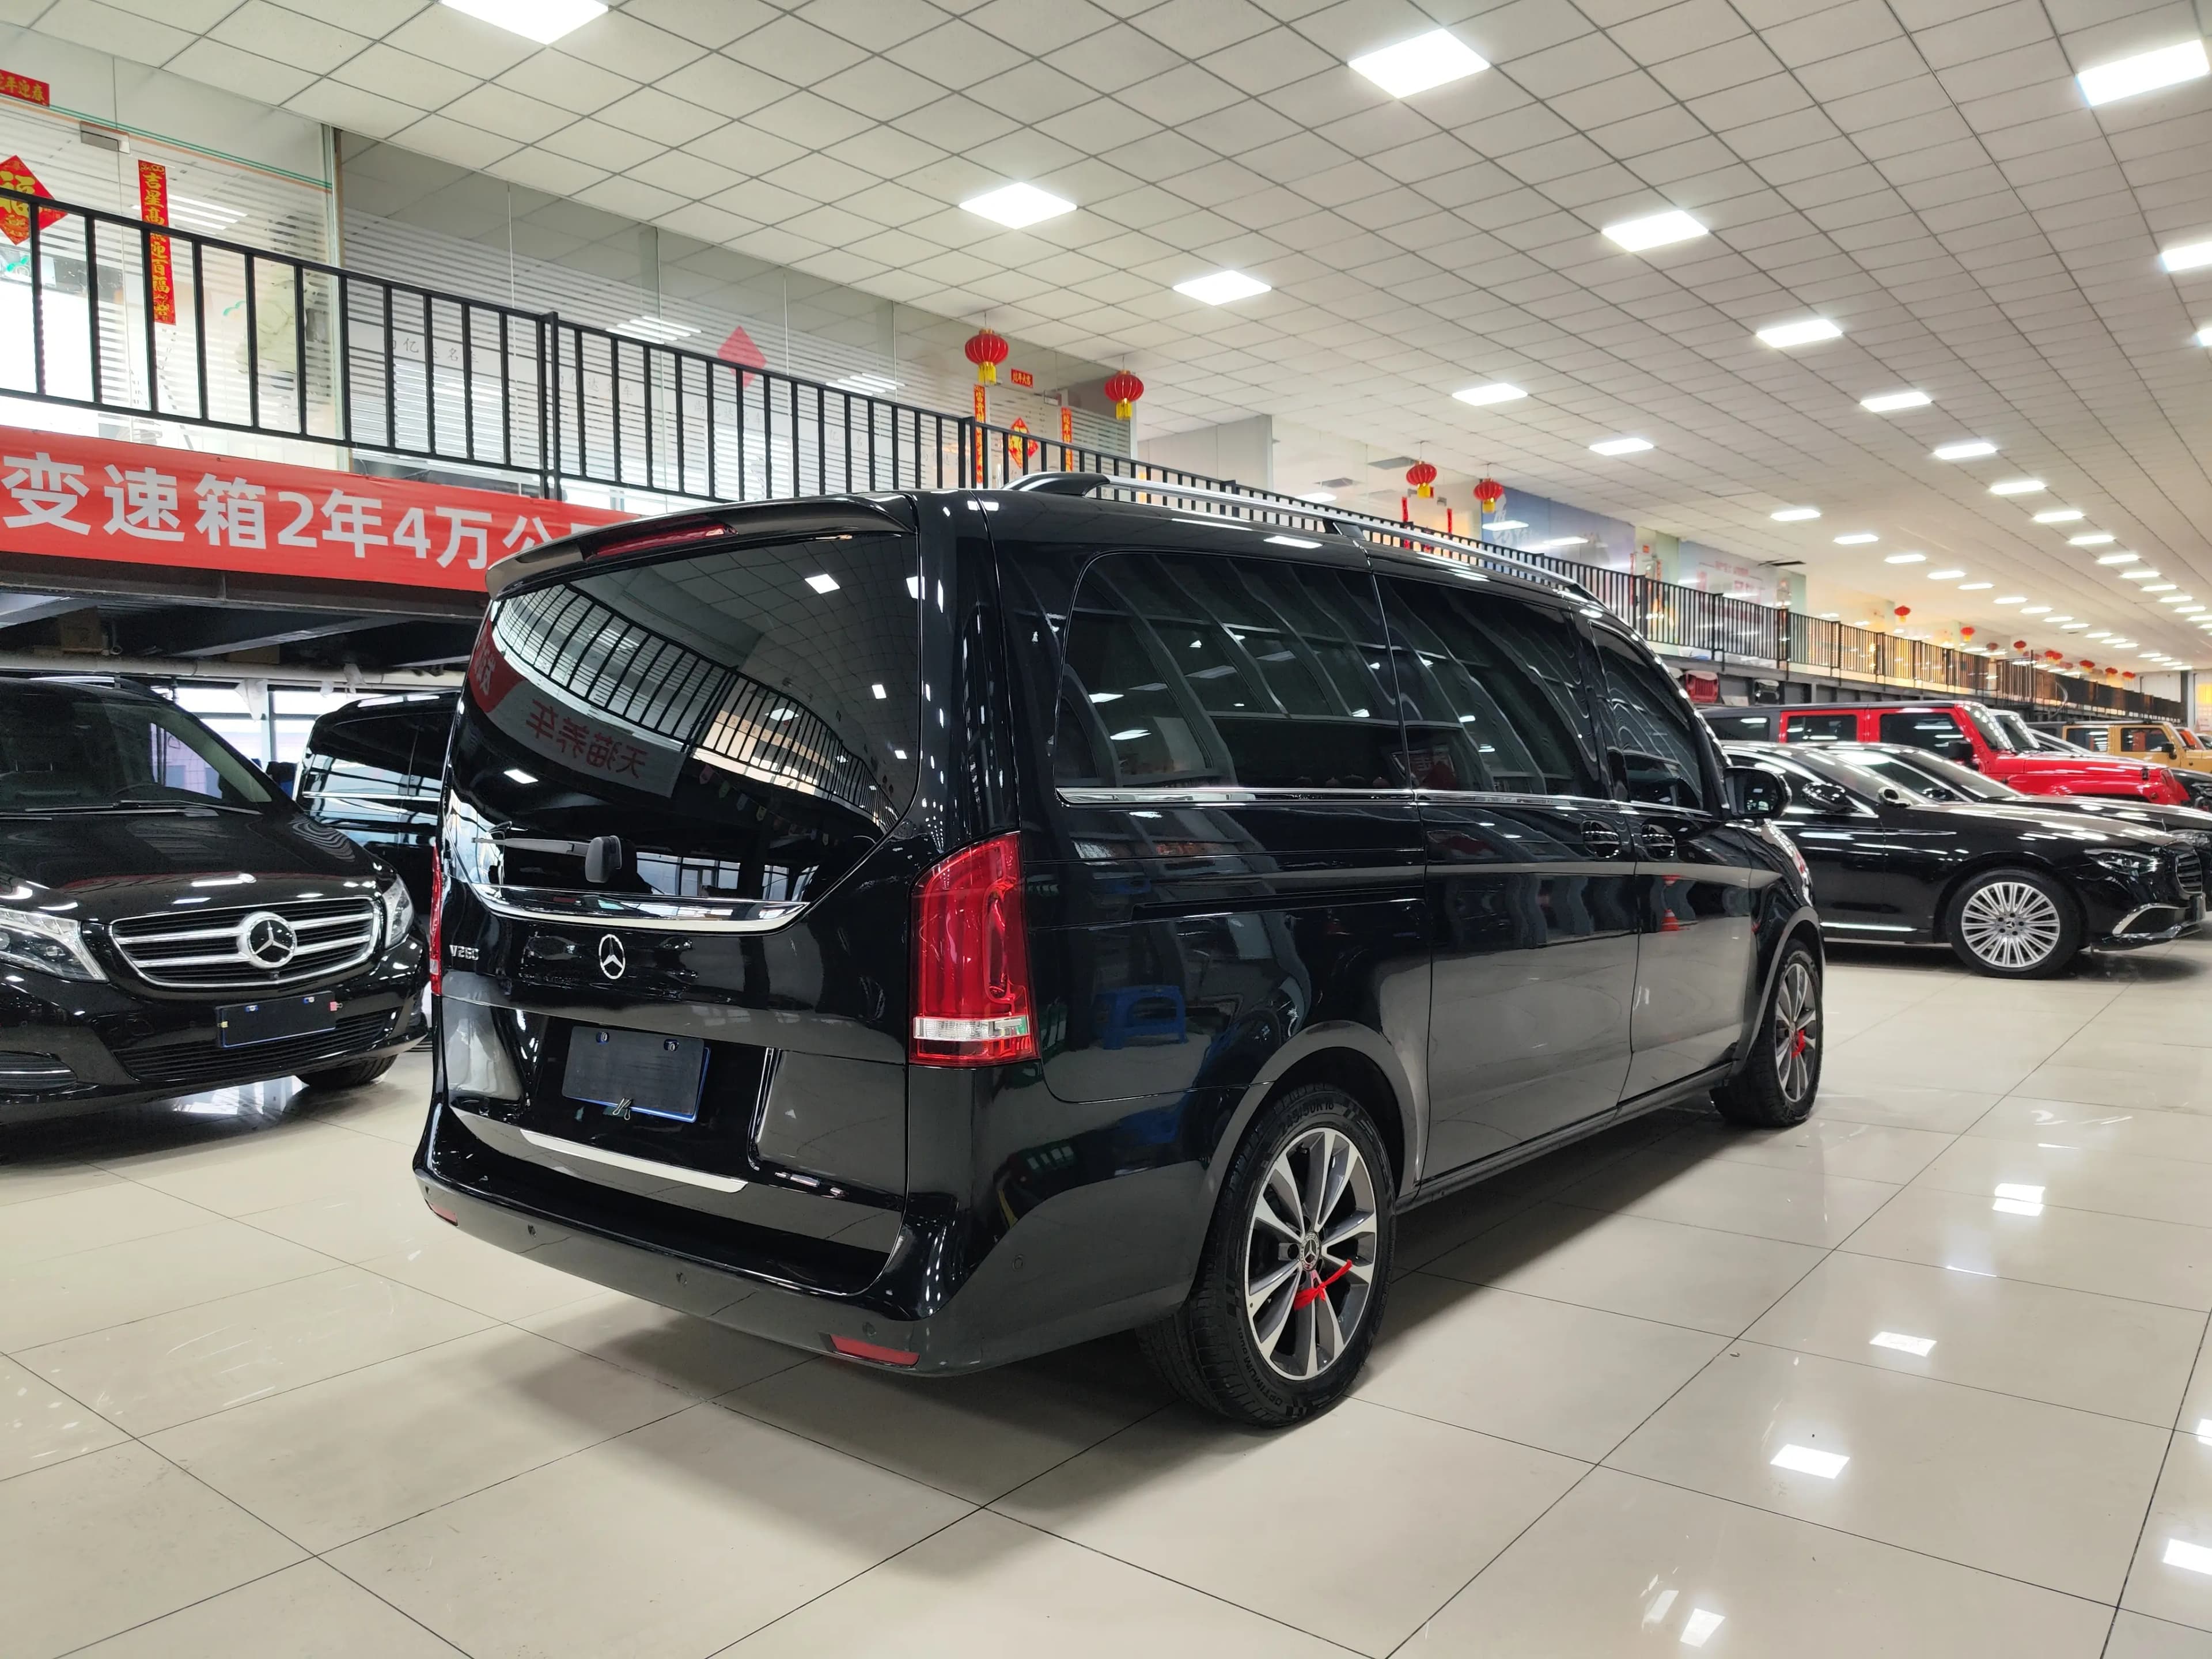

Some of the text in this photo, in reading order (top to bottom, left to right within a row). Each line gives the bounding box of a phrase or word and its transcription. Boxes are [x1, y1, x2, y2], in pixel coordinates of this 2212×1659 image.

[2, 452, 604, 570] 变速箱2年4万公
[449, 945, 479, 960] V260
[1244, 1355, 1283, 1407] OPTIMUM
